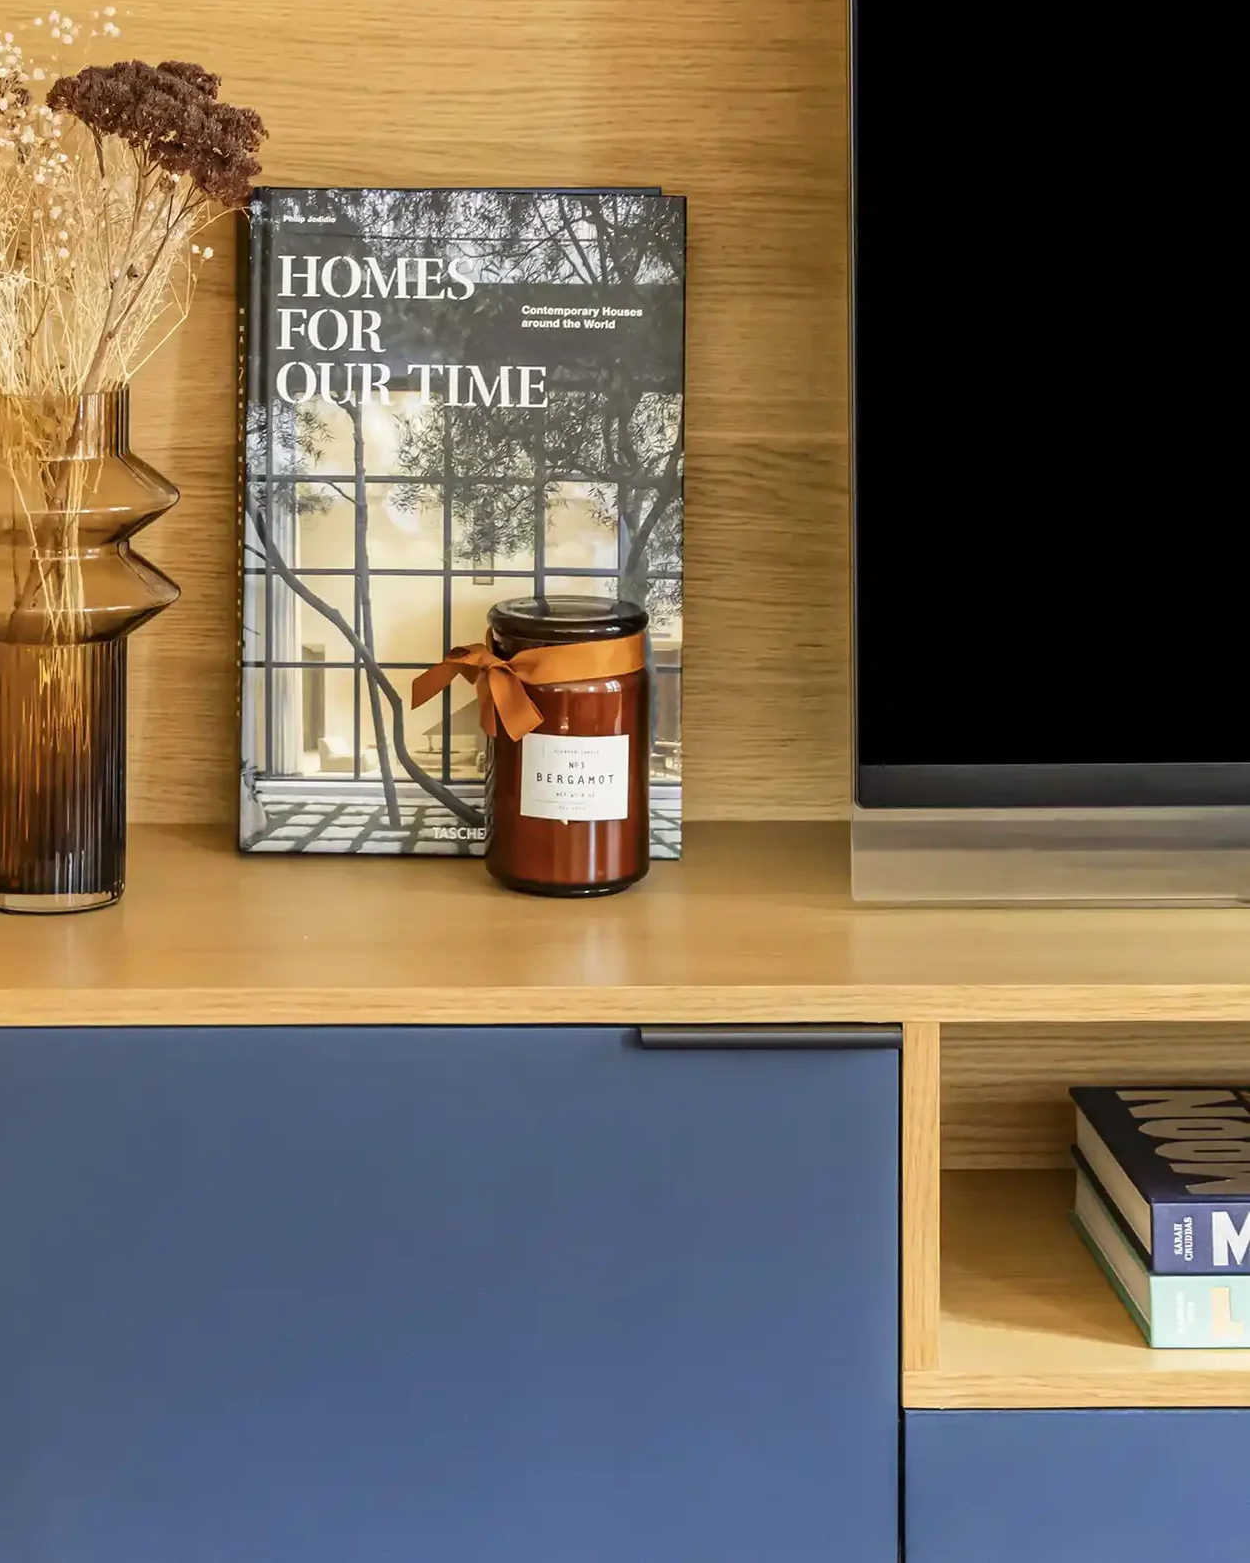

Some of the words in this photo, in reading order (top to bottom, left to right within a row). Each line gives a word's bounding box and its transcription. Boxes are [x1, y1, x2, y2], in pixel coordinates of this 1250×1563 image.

[283, 214, 305, 224] Philip
[307, 214, 336, 223] Jodidio
[277, 254, 475, 300] HOMES
[521, 305, 601, 318] Contemporary
[602, 306, 643, 317] Houses
[276, 308, 386, 353] FOR
[521, 318, 561, 329] around
[562, 318, 582, 329] the
[583, 318, 616, 330] World
[275, 361, 396, 407] OUR
[408, 364, 549, 409] TIME
[536, 772, 615, 785] BERGAMOT
[433, 826, 486, 840] TASCHE
[1173, 1223, 1183, 1255] SARAH
[1183, 1216, 1193, 1261] CRUDDAS
